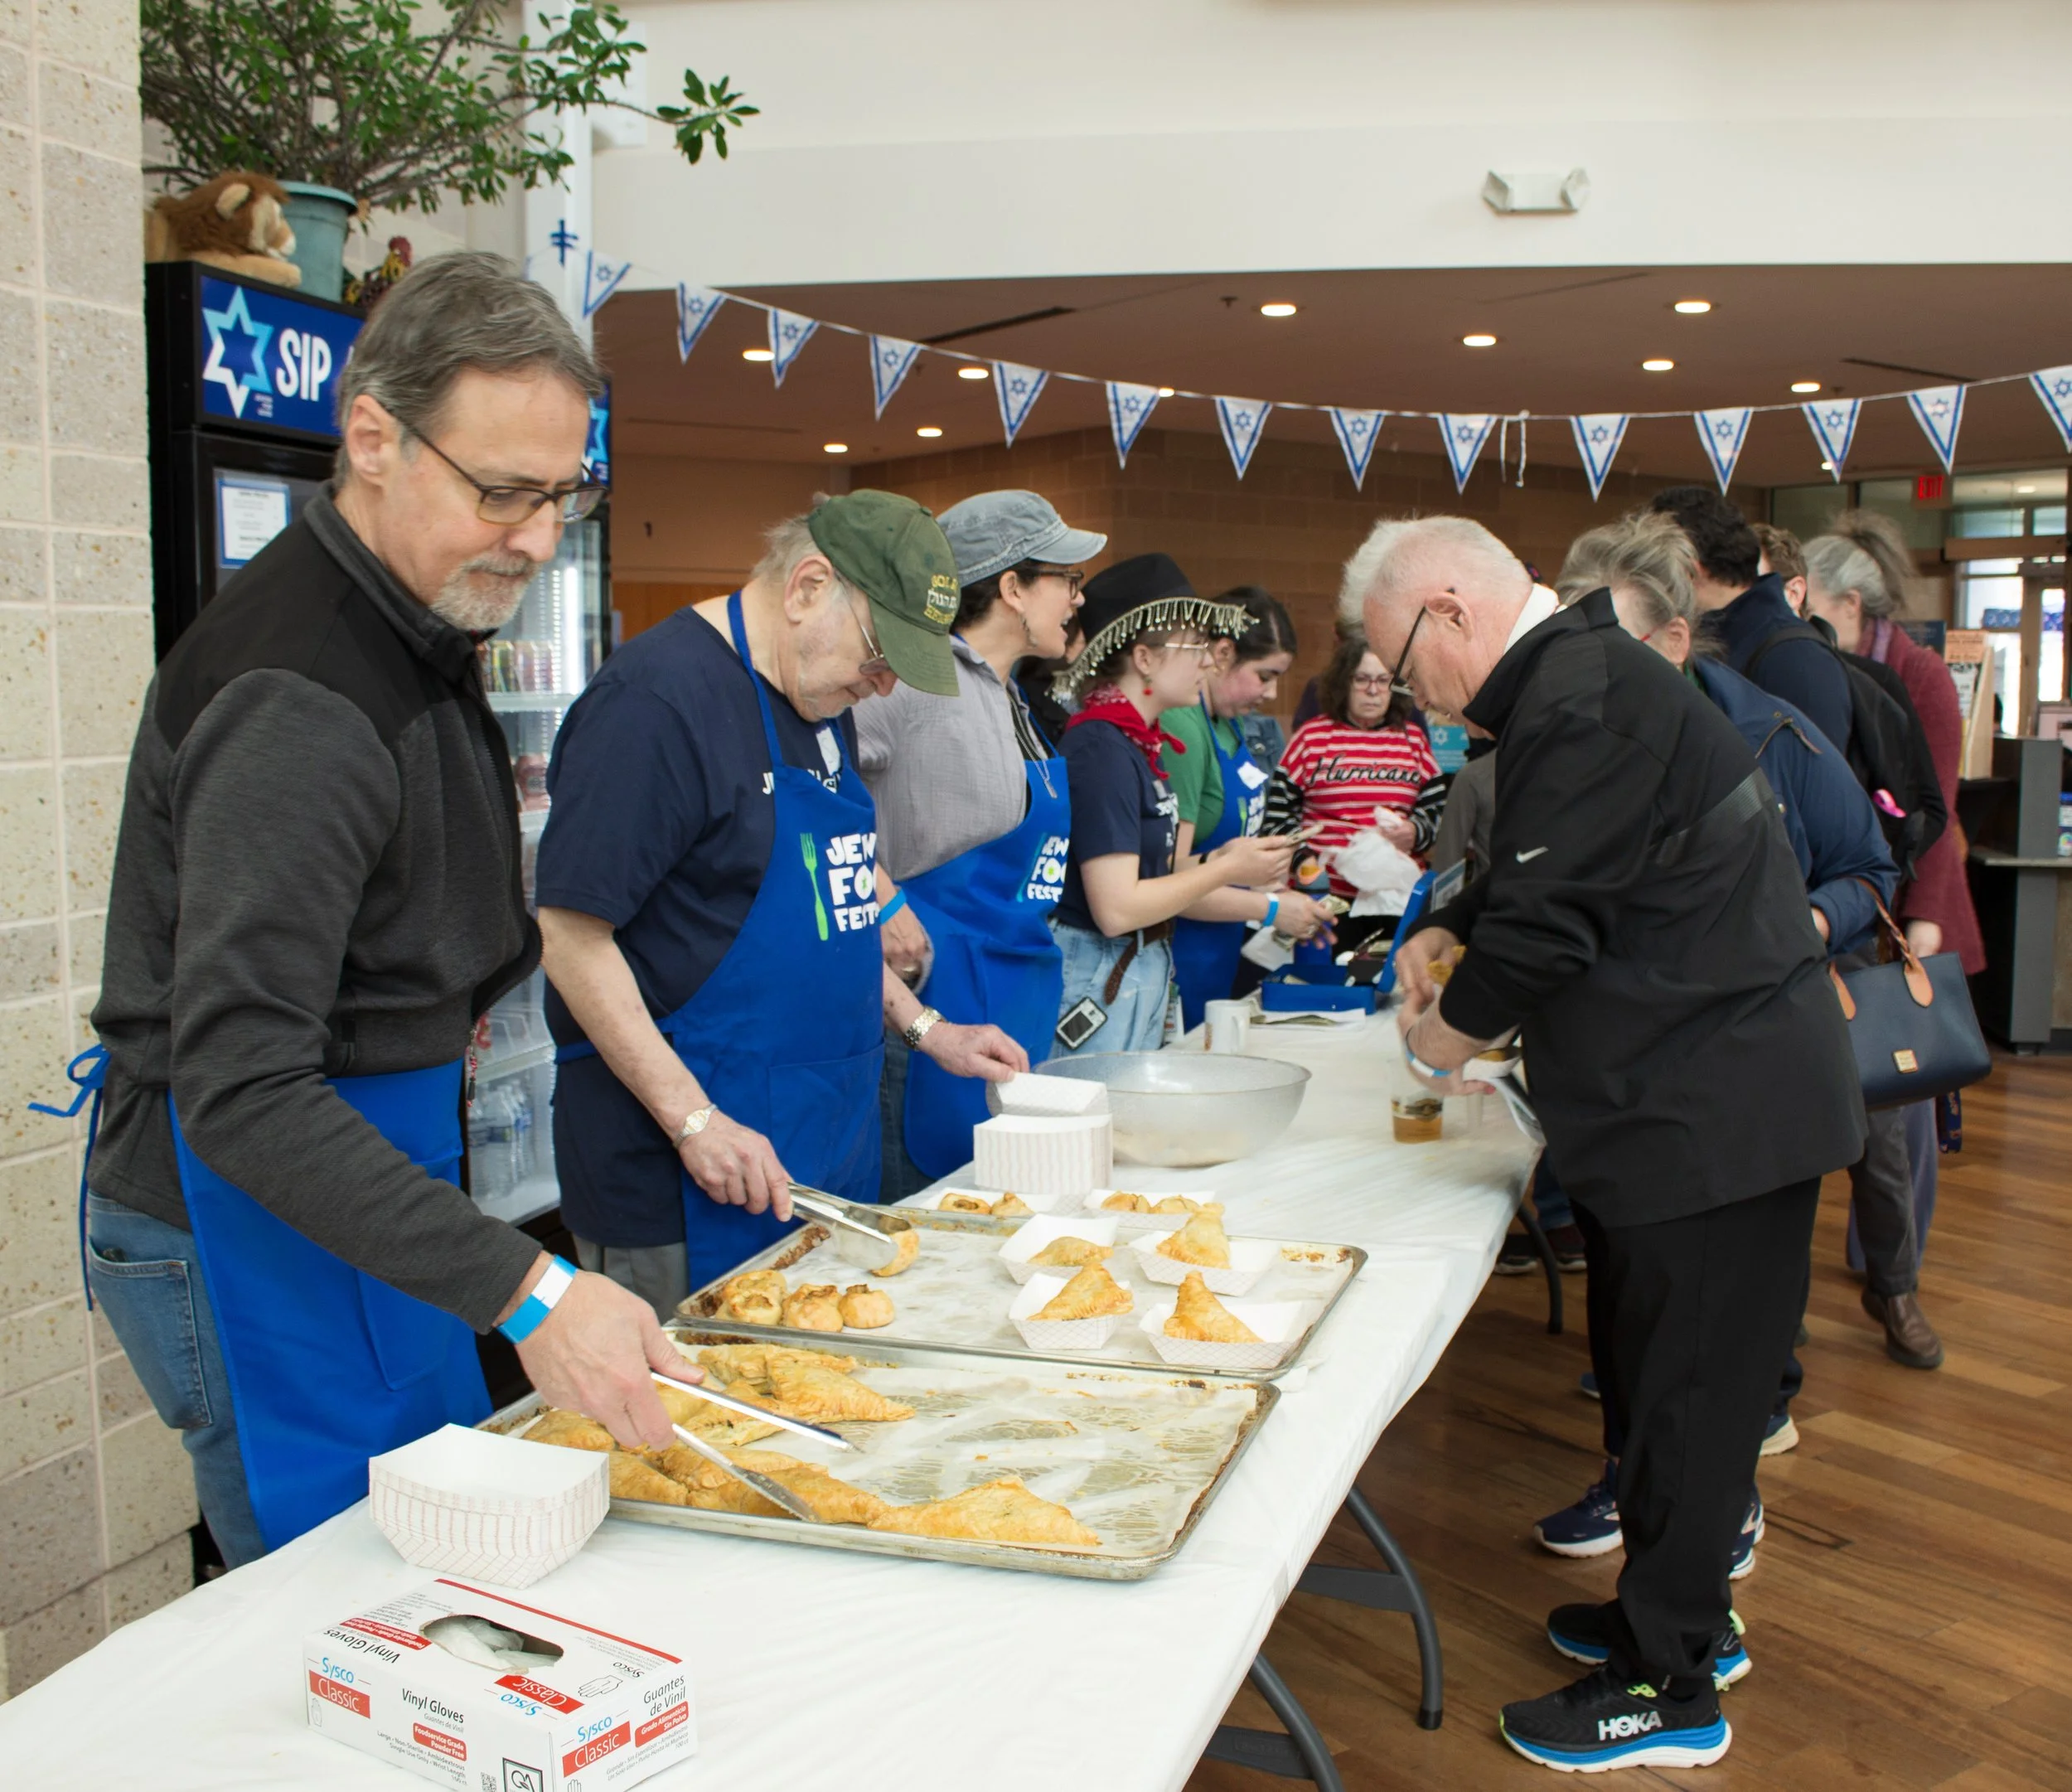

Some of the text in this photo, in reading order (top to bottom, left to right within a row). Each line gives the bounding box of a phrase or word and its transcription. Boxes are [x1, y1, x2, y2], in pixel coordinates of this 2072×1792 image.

[276, 327, 332, 402] SIP
[1918, 476, 1944, 499] EXIT
[1310, 753, 1421, 787] Hurricane
[1031, 856, 1067, 884] FO
[828, 865, 878, 906] FO
[323, 1630, 401, 1664] Vinyl Gloves
[322, 1657, 355, 1684] Sysco
[612, 1661, 646, 1678] Sysco
[317, 1678, 361, 1712] Classic
[512, 1677, 568, 1707] Classic
[643, 1674, 685, 1704] Guantes
[650, 1686, 686, 1717] de Vinil
[402, 1688, 465, 1724] Vinyl Gloves
[501, 1693, 543, 1717] Sysco
[414, 1725, 464, 1751] Foodservice Grade
[578, 1717, 612, 1742] Sysco
[1597, 1711, 1663, 1741] HOKA
[430, 1740, 465, 1759] Powder Free
[574, 1733, 620, 1768] Classic
